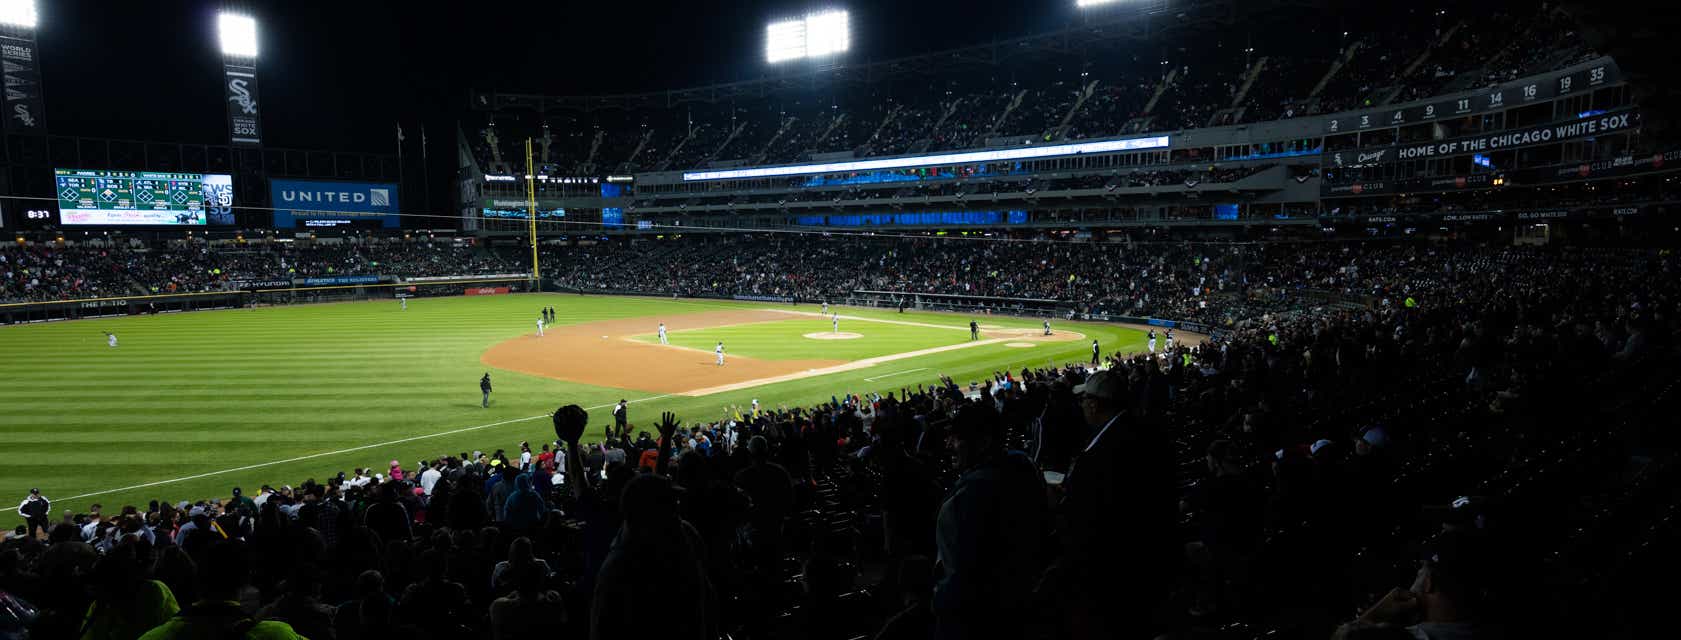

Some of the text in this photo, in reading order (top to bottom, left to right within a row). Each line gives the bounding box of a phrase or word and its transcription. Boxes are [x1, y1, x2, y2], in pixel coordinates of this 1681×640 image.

[1, 44, 32, 53] WORLD
[1591, 68, 1604, 81] 35
[1560, 77, 1571, 90] 19
[1523, 85, 1536, 97] 16
[1490, 92, 1502, 104] 14
[1458, 99, 1469, 110] 11
[1426, 105, 1434, 115] 9
[1360, 115, 1369, 124] 3
[1394, 111, 1402, 120] 4
[1331, 120, 1338, 129] 2
[233, 128, 256, 136] SOX
[1399, 114, 1629, 159] HOME OF THE CHICAGO WHITE SOX
[1363, 183, 1384, 191] CLUB
[281, 190, 367, 203] UNITED
[28, 210, 50, 219] 8:37
[252, 280, 291, 288] HYUNDAI
